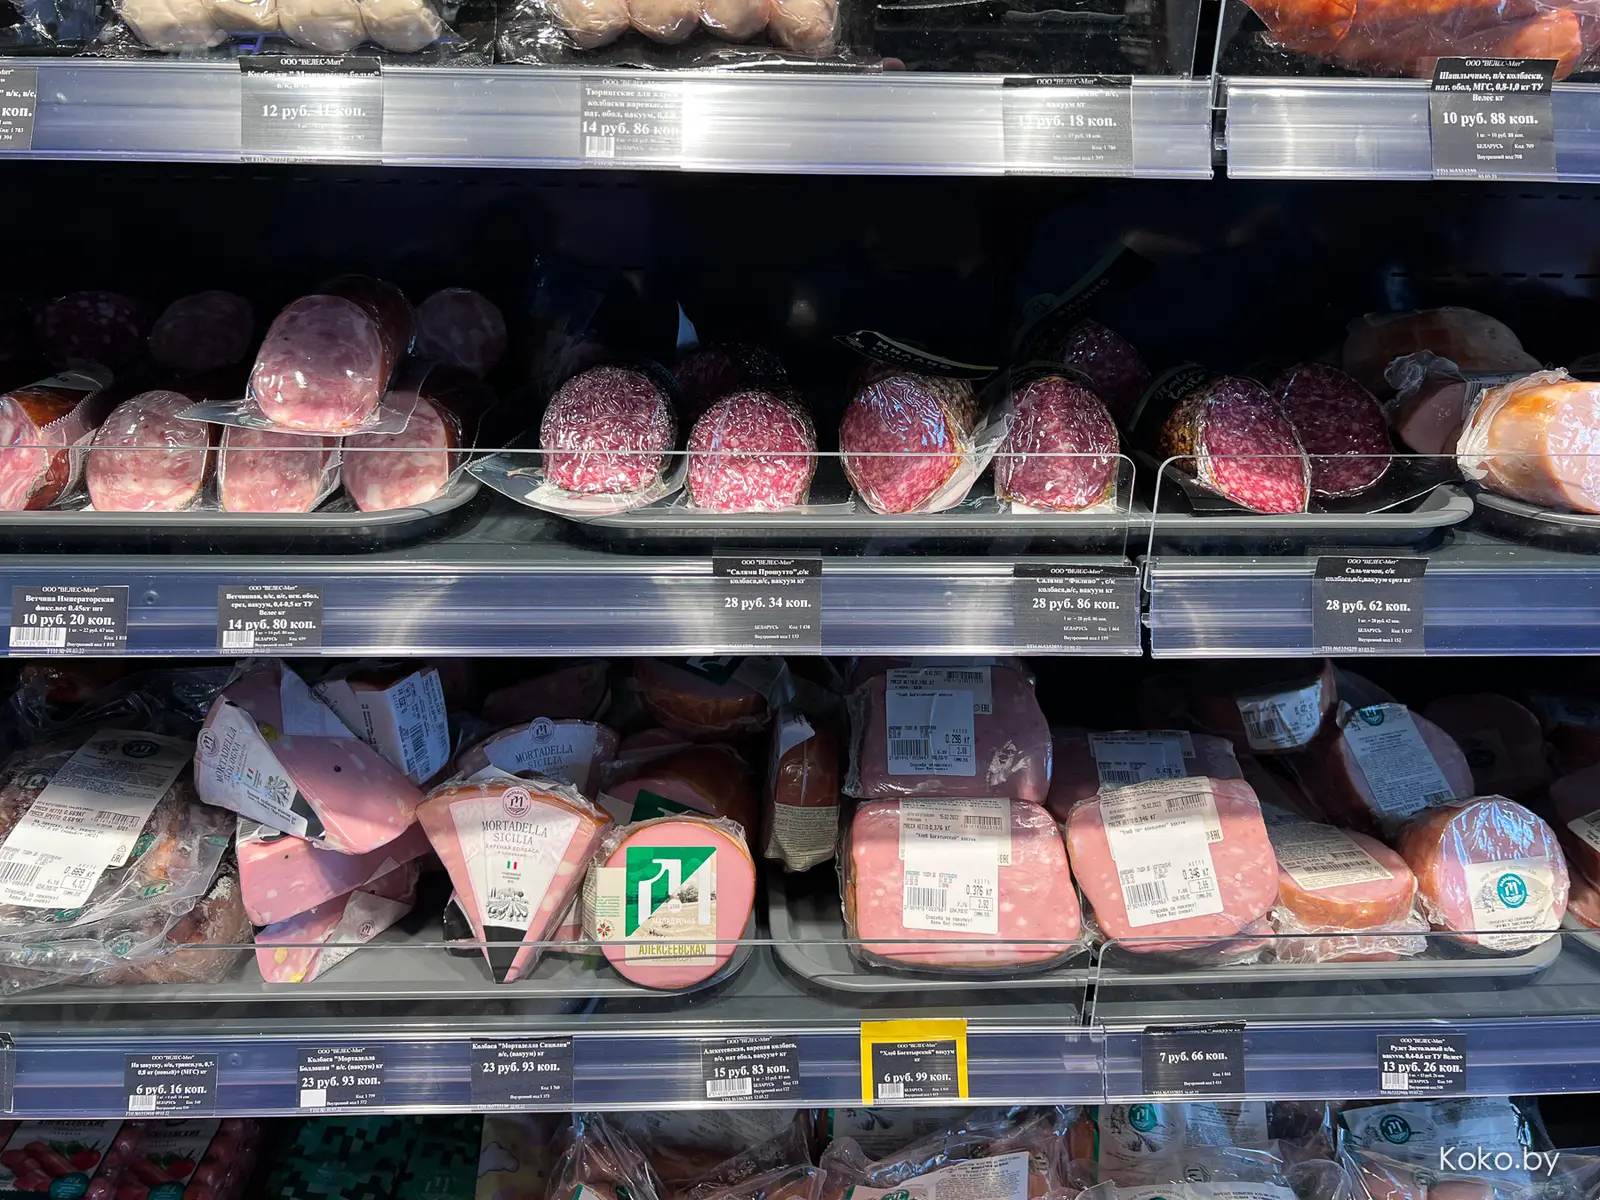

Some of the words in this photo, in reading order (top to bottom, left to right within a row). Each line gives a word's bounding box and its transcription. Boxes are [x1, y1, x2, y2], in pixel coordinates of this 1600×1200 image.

[1506, 72, 1543, 80] колбаски,
[1452, 83, 1471, 92] обол,
[1472, 83, 1494, 92] МГС,
[1495, 83, 1519, 92] 0,8-1,0
[1532, 83, 1544, 91] ТУ
[588, 100, 624, 108] колбаски
[2, 108, 32, 116] коп.
[262, 105, 277, 117] 12
[282, 105, 310, 119] руб.
[1036, 115, 1065, 129] руб.
[1069, 115, 1084, 127] 18
[1088, 118, 1116, 127] коп.
[1443, 112, 1457, 124] 10
[1461, 113, 1487, 127] руб.
[1490, 113, 1506, 124] 88
[1509, 115, 1538, 124] коп.
[582, 121, 597, 133] 14
[601, 122, 629, 136] руб.
[633, 123, 649, 135] 86
[57, 595, 115, 603] Императорская
[724, 597, 738, 608] 28
[741, 597, 765, 610] руб.
[769, 597, 782, 607] 34
[786, 599, 812, 607] коп.
[1032, 598, 1046, 609] 28
[1049, 598, 1074, 611] руб.
[1077, 598, 1091, 609] 86
[1094, 601, 1119, 609] коп.
[1326, 600, 1340, 610] 28
[1342, 600, 1366, 613] руб.
[1369, 601, 1383, 611] 62
[1386, 603, 1411, 612] коп.
[23, 614, 37, 624] 10
[40, 614, 66, 627] руб.
[70, 614, 84, 625] 20
[88, 617, 115, 625] коп.
[228, 619, 242, 629] 14
[245, 619, 270, 630] руб.
[273, 619, 287, 629] 80
[290, 621, 316, 629] коп.
[216, 726, 238, 784] MORTADELLA
[515, 744, 574, 764] MORTADELLA
[224, 741, 241, 784] BOLOGNA
[527, 756, 563, 770] SICILIA
[482, 820, 548, 838] MORTADELLA
[494, 833, 533, 846] SICILIA
[966, 885, 984, 895] 0.376
[978, 900, 989, 909] 2.92
[639, 944, 707, 955] АЛЕКСЕЕВСКАЯ
[1160, 1053, 1166, 1061] 7
[1168, 1052, 1189, 1063] руб.
[1192, 1051, 1203, 1060] 66
[1206, 1052, 1228, 1060] коп.
[483, 1063, 495, 1072] 23
[498, 1062, 519, 1074] руб.
[522, 1062, 534, 1072] 93
[538, 1063, 560, 1071] коп.
[714, 1067, 725, 1077] 15
[728, 1066, 749, 1079] руб.
[752, 1065, 764, 1074] 83
[767, 1065, 789, 1073] коп.
[1383, 1062, 1395, 1071] 13
[1398, 1062, 1421, 1073] руб.
[1423, 1062, 1436, 1072] 26
[1440, 1064, 1463, 1072] коп.
[302, 1077, 314, 1087] 23
[317, 1076, 339, 1089] руб.
[342, 1076, 354, 1085] 93
[358, 1077, 380, 1085] коп.
[884, 1073, 891, 1082] 6
[893, 1073, 913, 1083] руб.
[916, 1072, 927, 1081] 99
[136, 1085, 142, 1094] 6
[146, 1084, 167, 1095] руб.
[170, 1084, 182, 1094] 16
[185, 1086, 207, 1094] коп.
